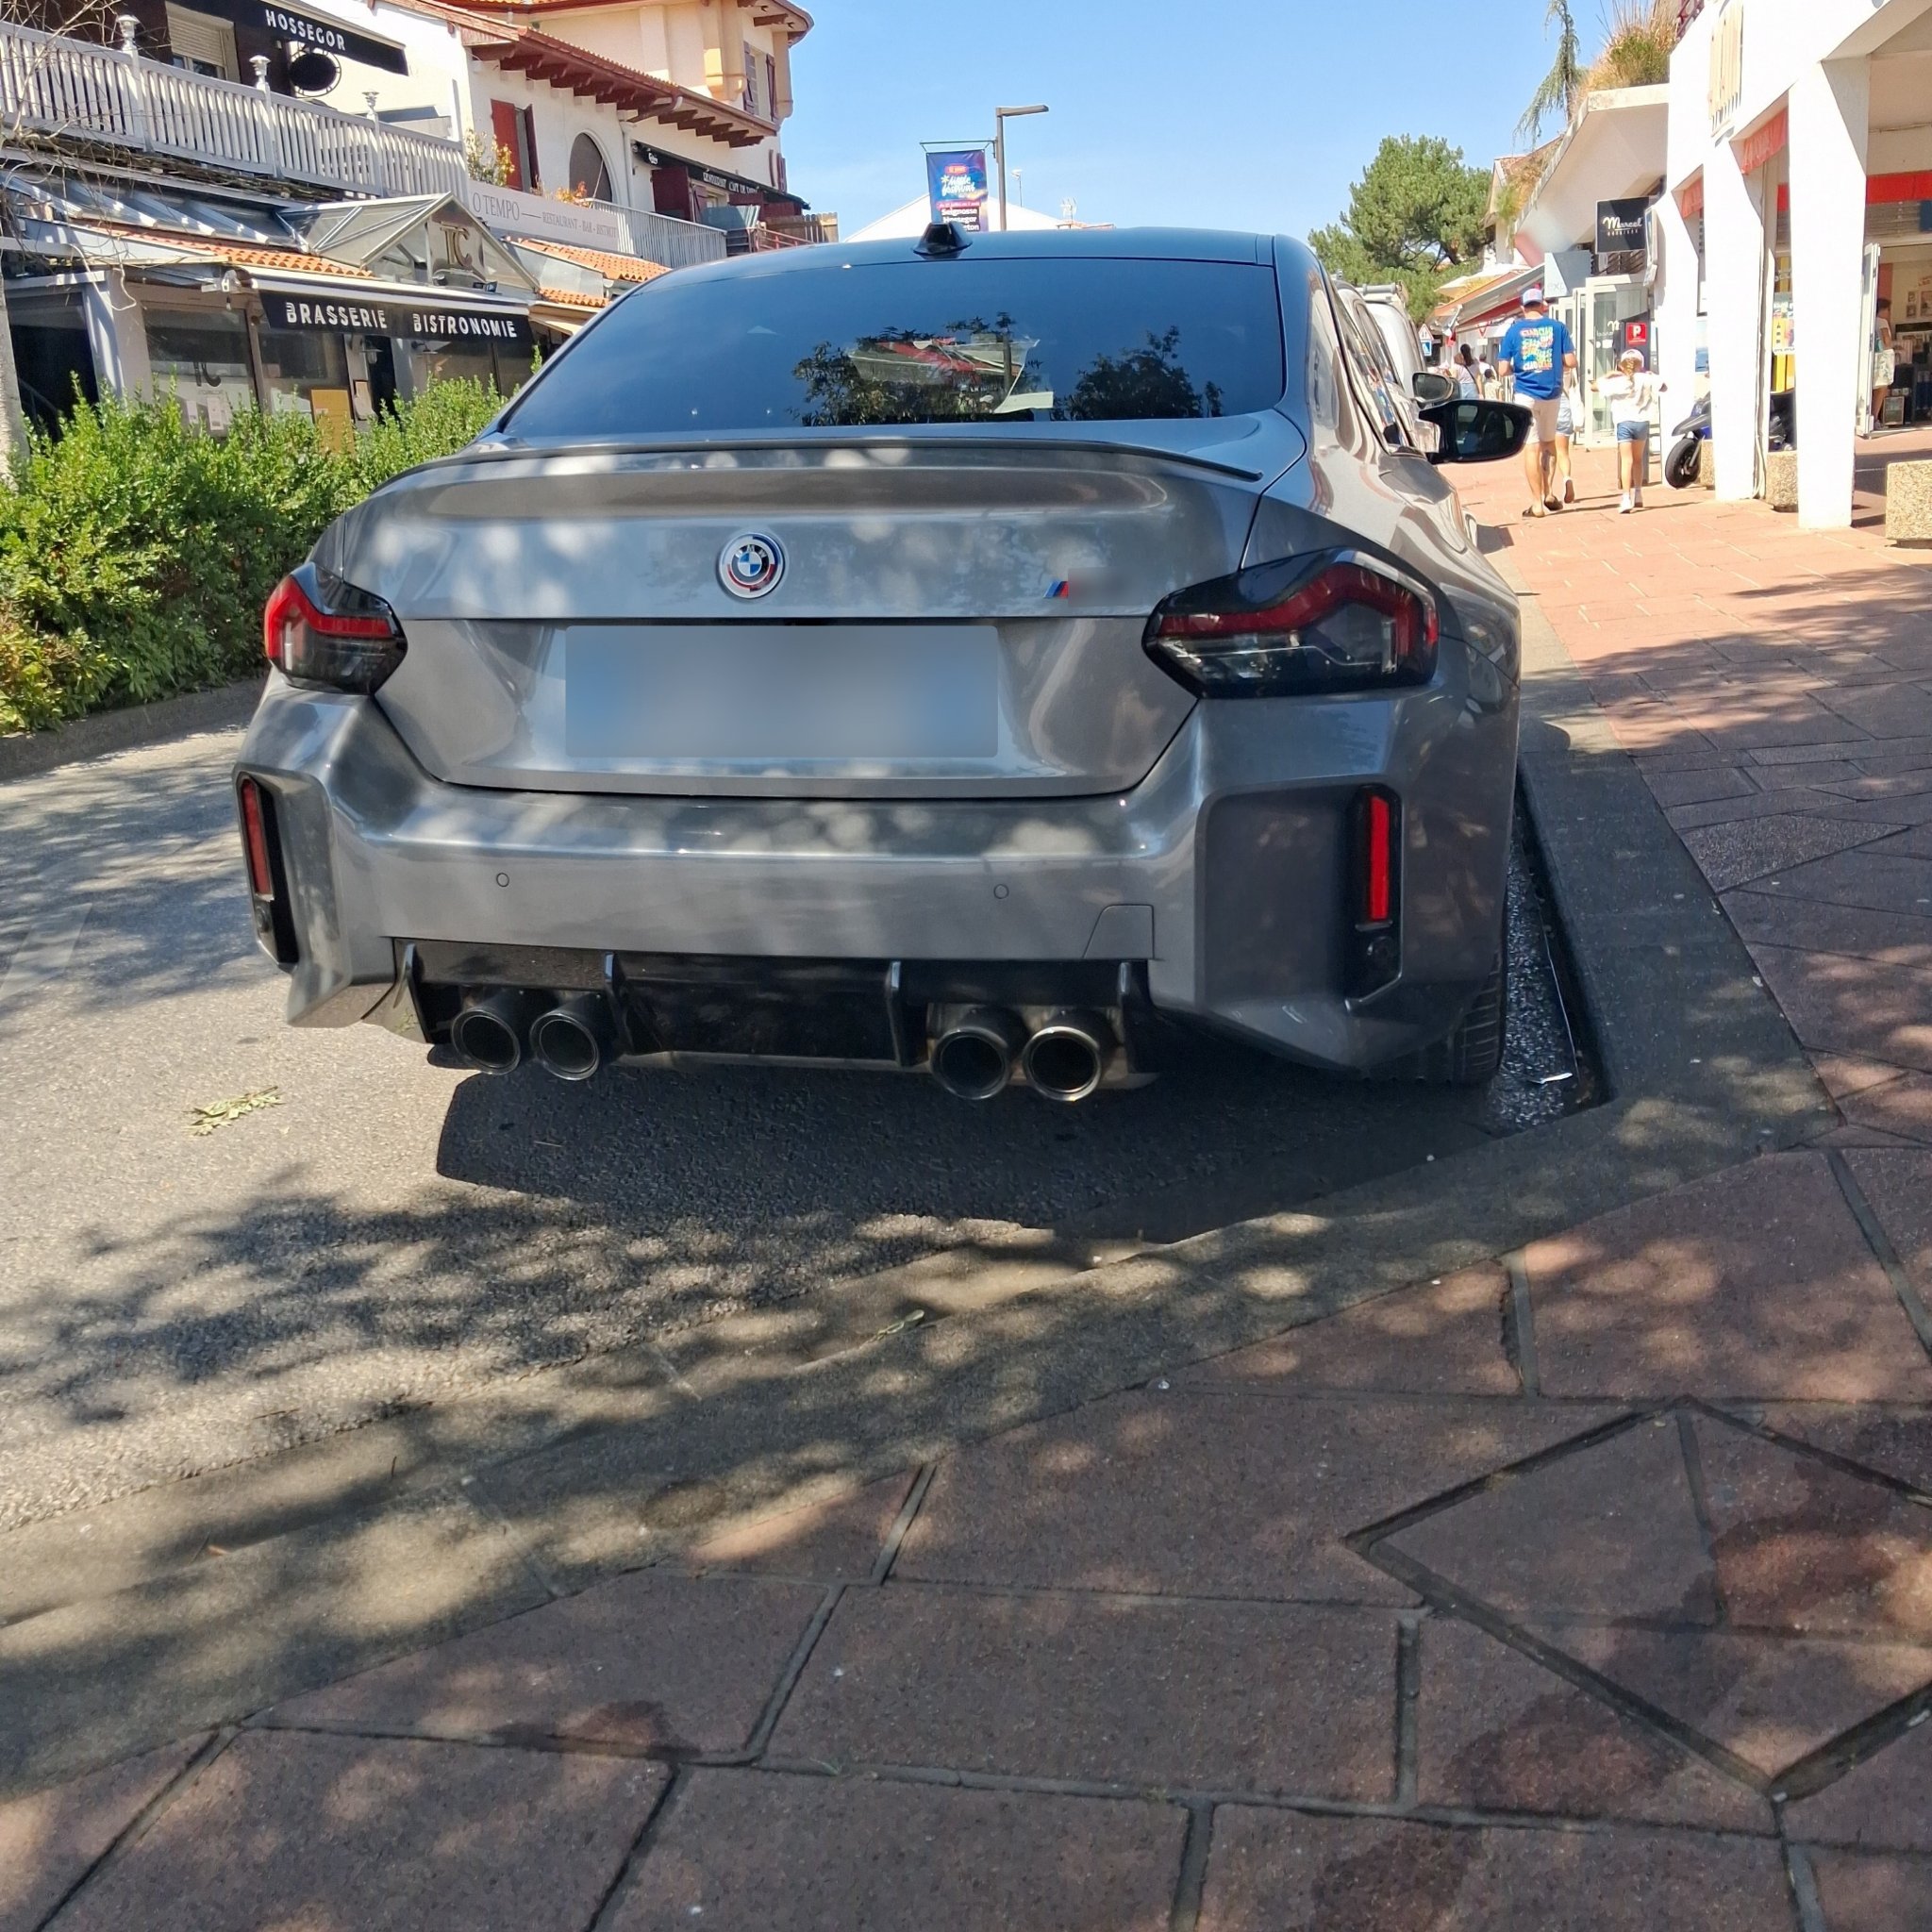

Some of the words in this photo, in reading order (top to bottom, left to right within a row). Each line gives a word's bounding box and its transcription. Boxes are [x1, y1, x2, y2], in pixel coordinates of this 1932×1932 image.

[265, 9, 346, 51] HOSSEGOR
[483, 194, 519, 221] TEMPO
[1602, 216, 1643, 229] Marcel
[286, 302, 388, 329] BRASSERIE
[413, 313, 518, 338] BISTRONOMIE
[1632, 325, 1641, 337] P
[735, 543, 768, 558] BMW
